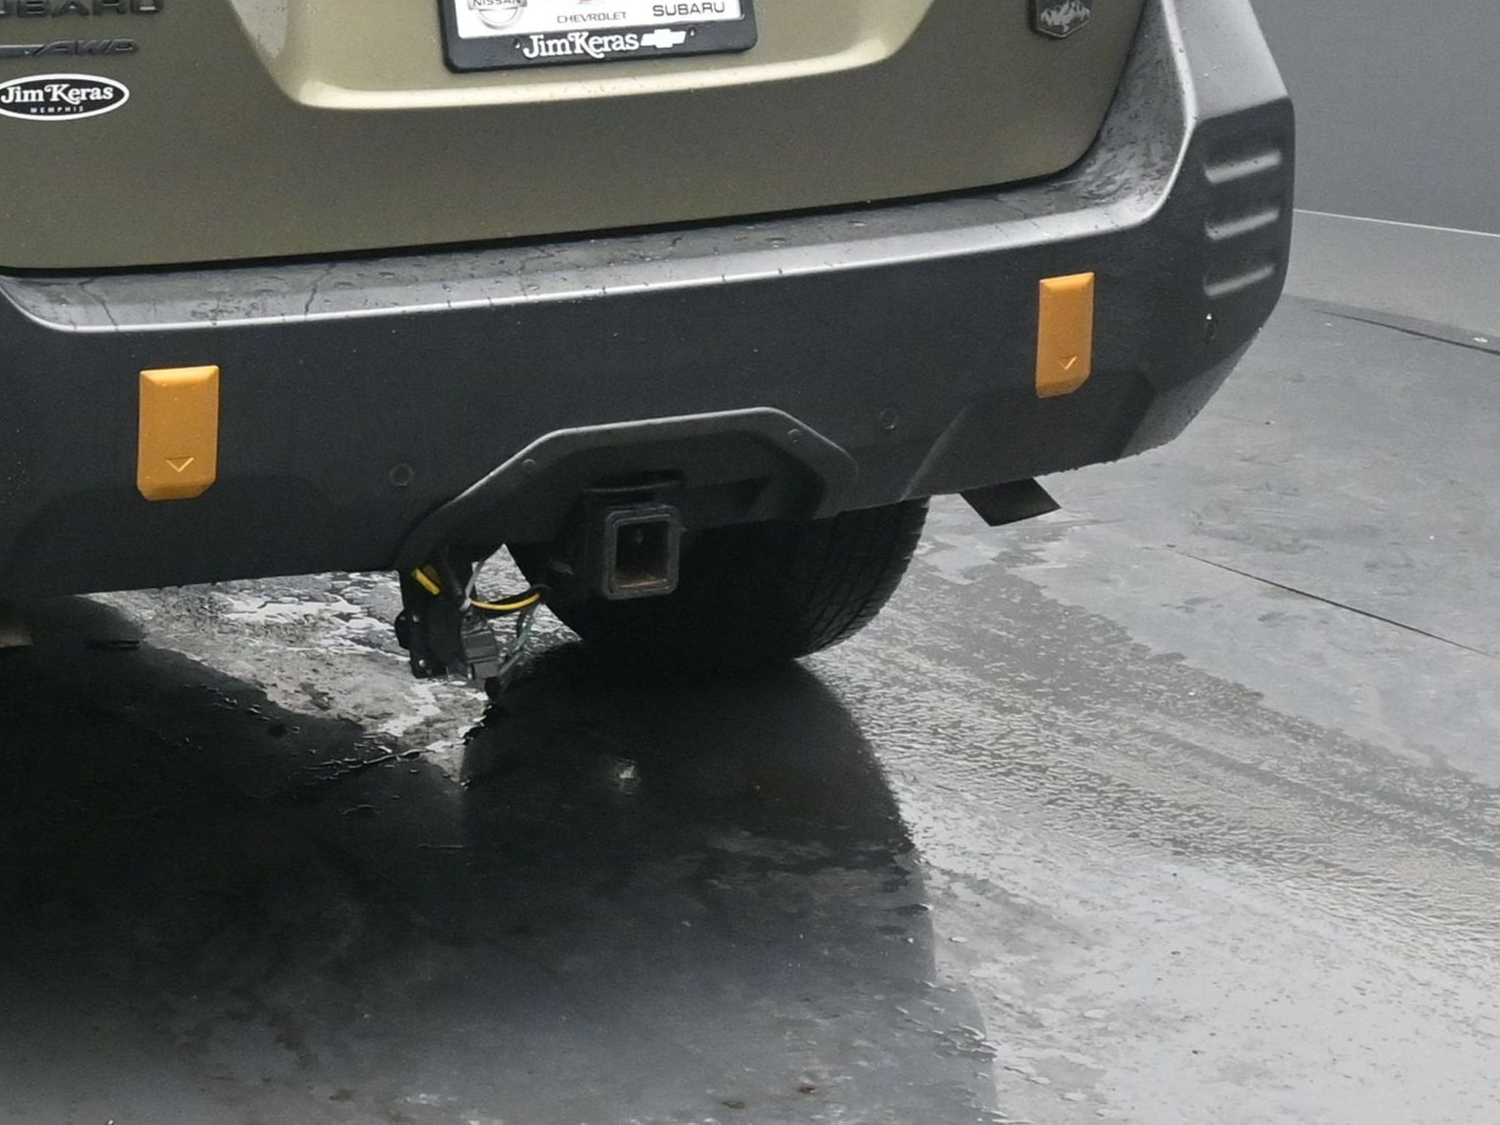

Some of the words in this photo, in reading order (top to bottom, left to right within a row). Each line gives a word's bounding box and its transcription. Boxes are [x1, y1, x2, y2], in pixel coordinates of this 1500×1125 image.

[653, 2, 725, 17] SUBARU
[557, 11, 627, 24] CHEVROLET
[33, 37, 140, 57] AWD
[30, 105, 84, 114] MEMPHIS
